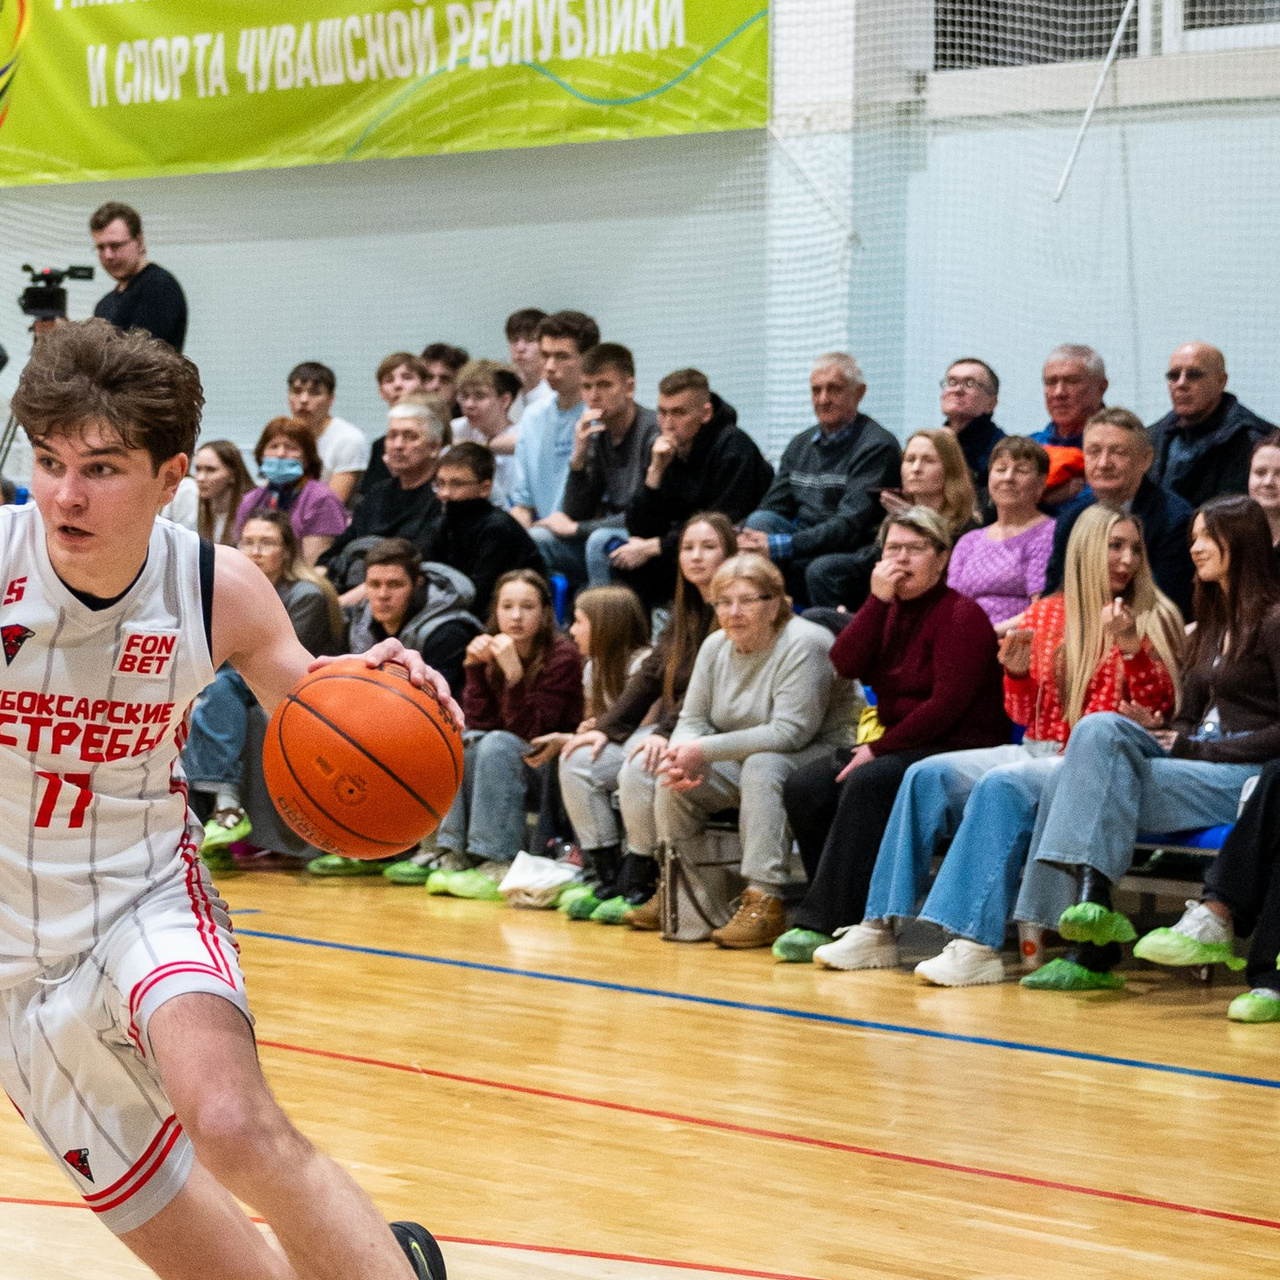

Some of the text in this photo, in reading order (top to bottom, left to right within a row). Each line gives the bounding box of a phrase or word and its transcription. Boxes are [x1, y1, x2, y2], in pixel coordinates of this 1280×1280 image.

[86, 43, 108, 109] И
[115, 32, 229, 106] СПОРТА
[125, 634, 178, 656] FON
[118, 654, 171, 675] BET
